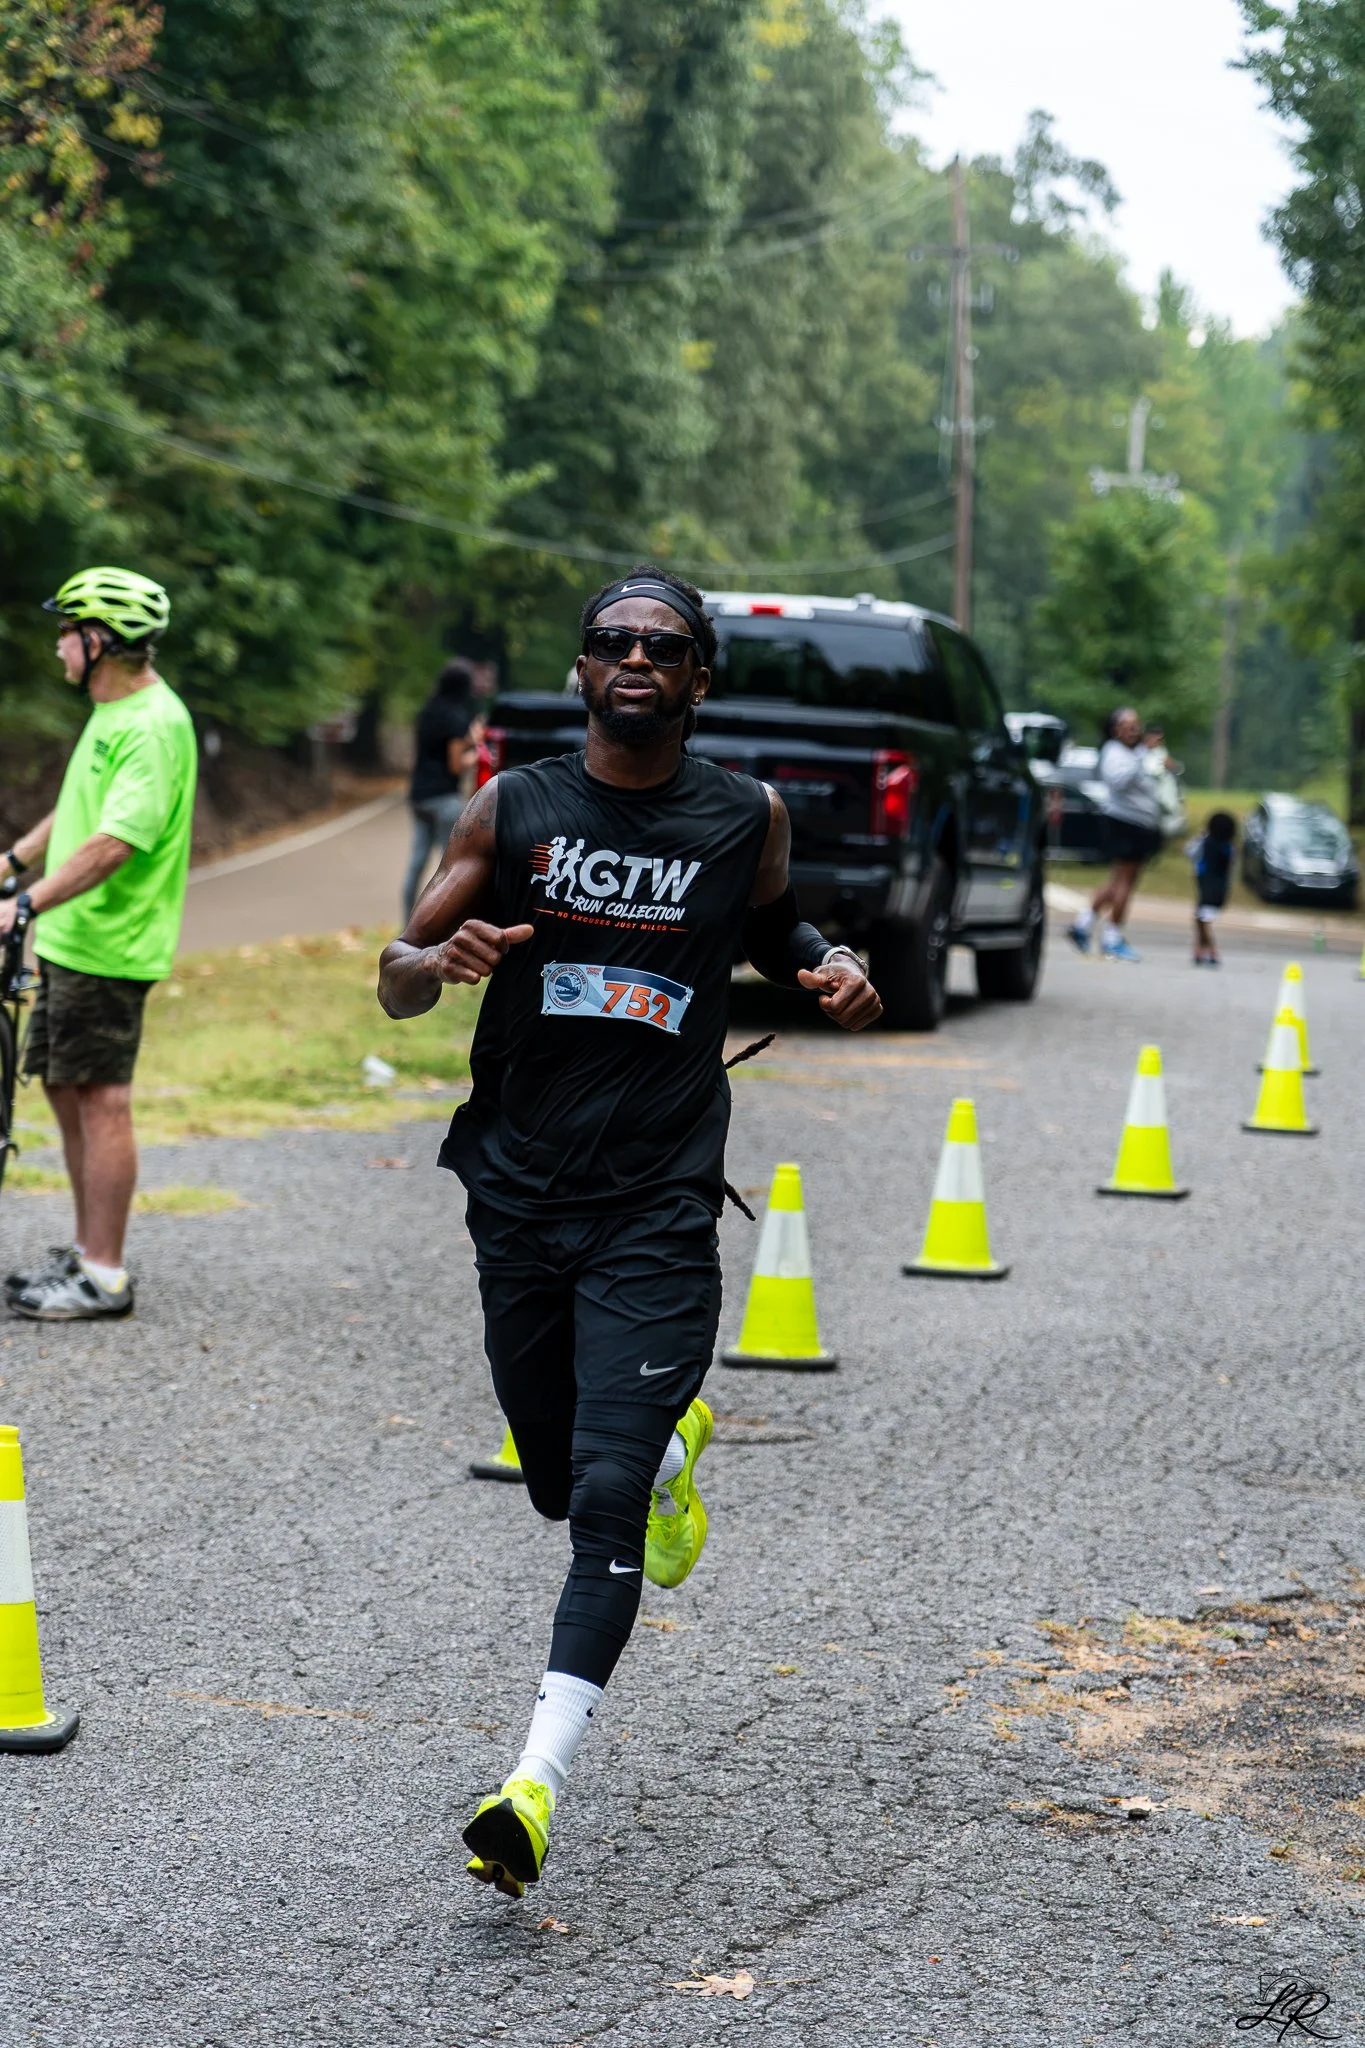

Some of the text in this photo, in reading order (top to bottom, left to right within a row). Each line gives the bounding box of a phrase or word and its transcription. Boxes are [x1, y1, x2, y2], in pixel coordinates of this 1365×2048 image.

[579, 849, 703, 903] GTW
[557, 911, 668, 932] NO EXCUSES JUST MILES
[573, 894, 686, 922] RUN COLLECTION
[600, 982, 671, 1029] 752
